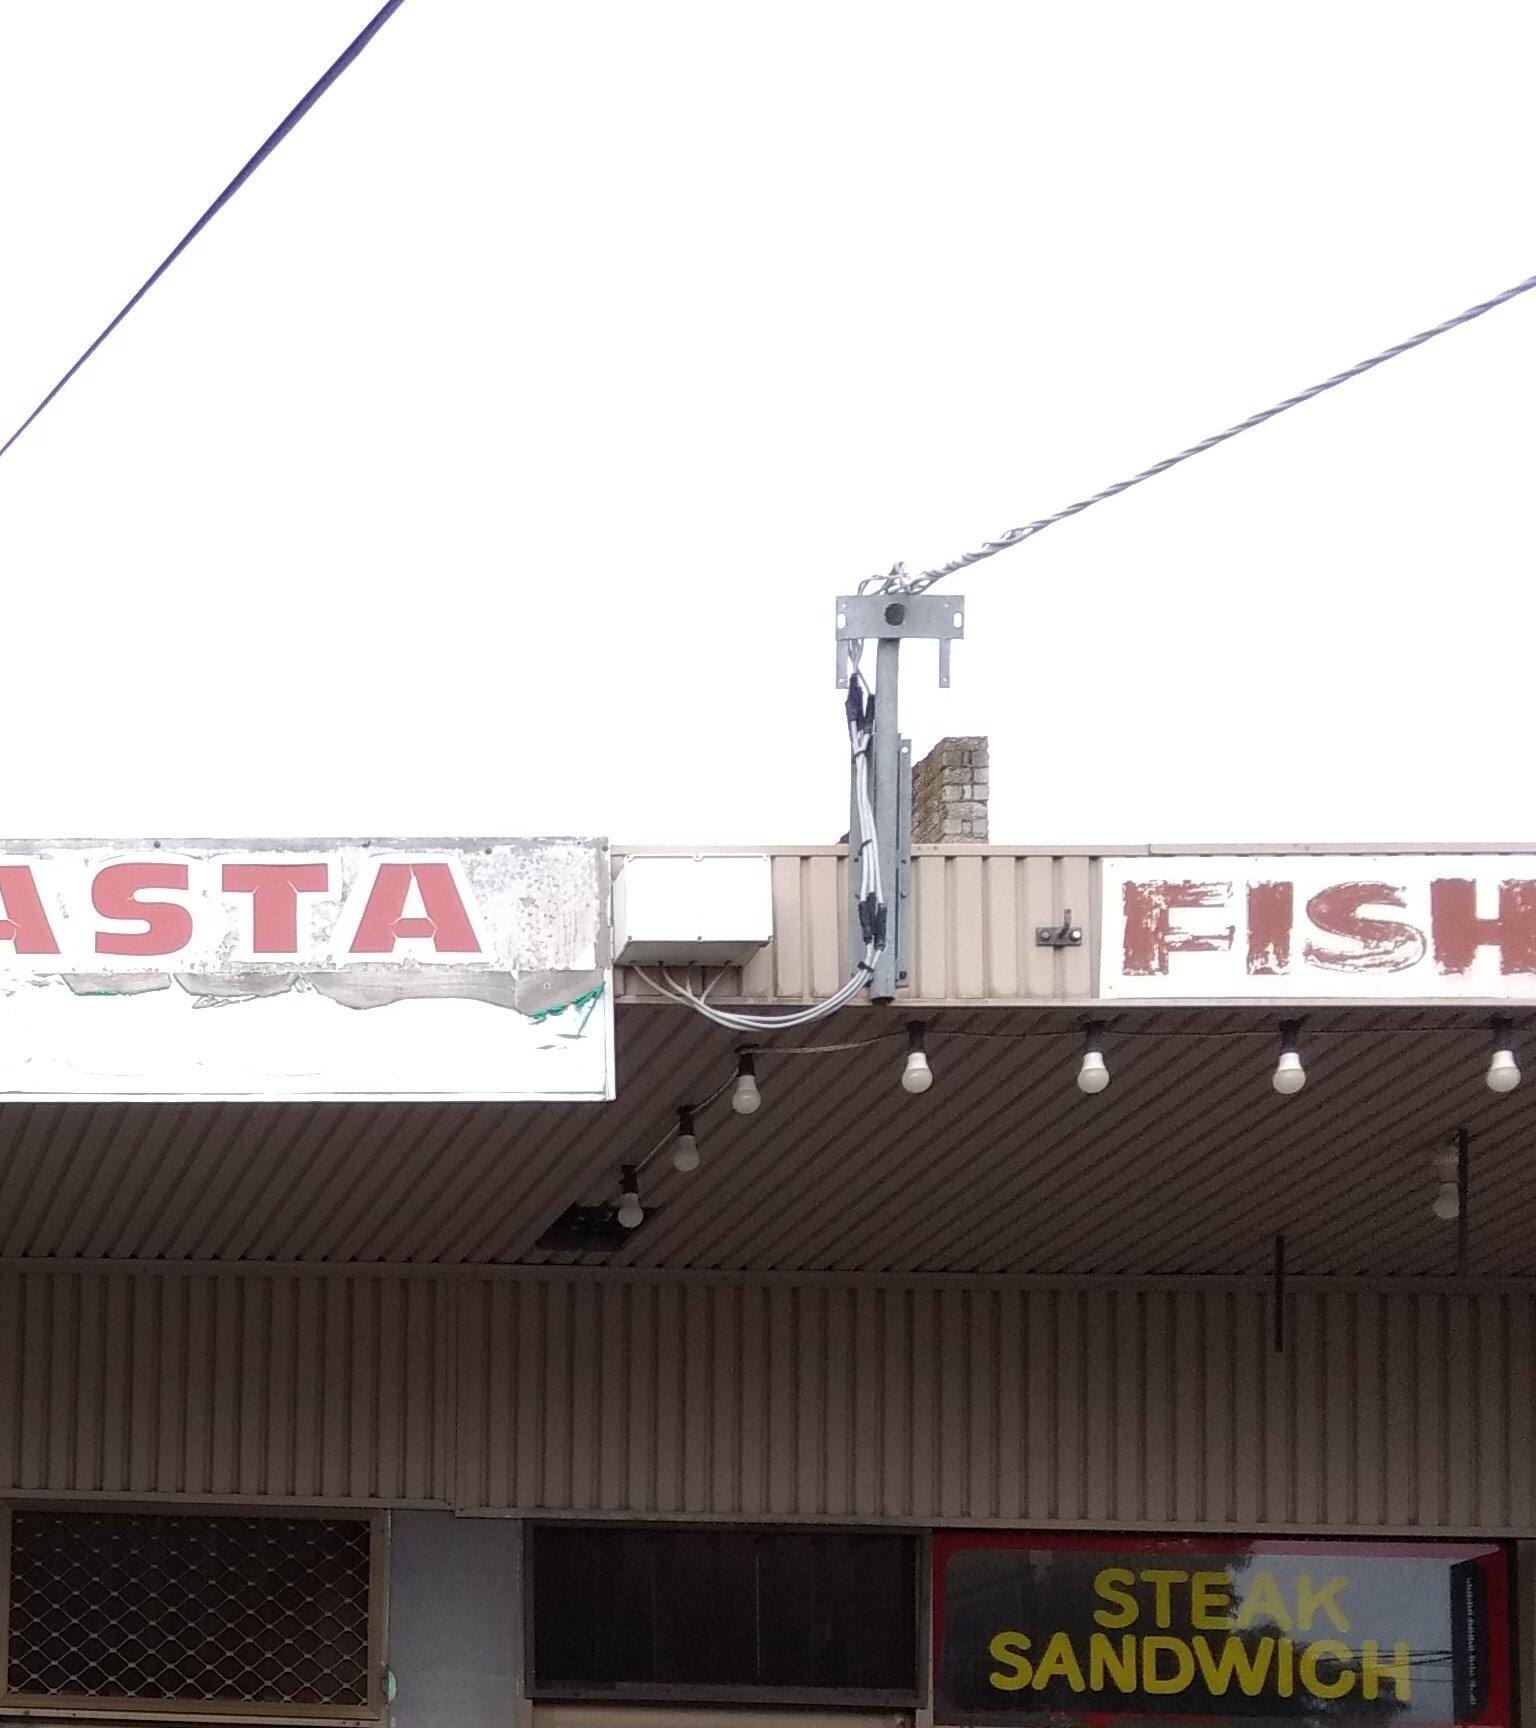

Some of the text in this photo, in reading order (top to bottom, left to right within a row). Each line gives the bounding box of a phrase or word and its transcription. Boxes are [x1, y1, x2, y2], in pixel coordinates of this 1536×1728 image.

[1121, 878, 1536, 975] FISH
[1094, 1568, 1351, 1634] STEAK
[989, 1630, 1412, 1703] SANDWICH
